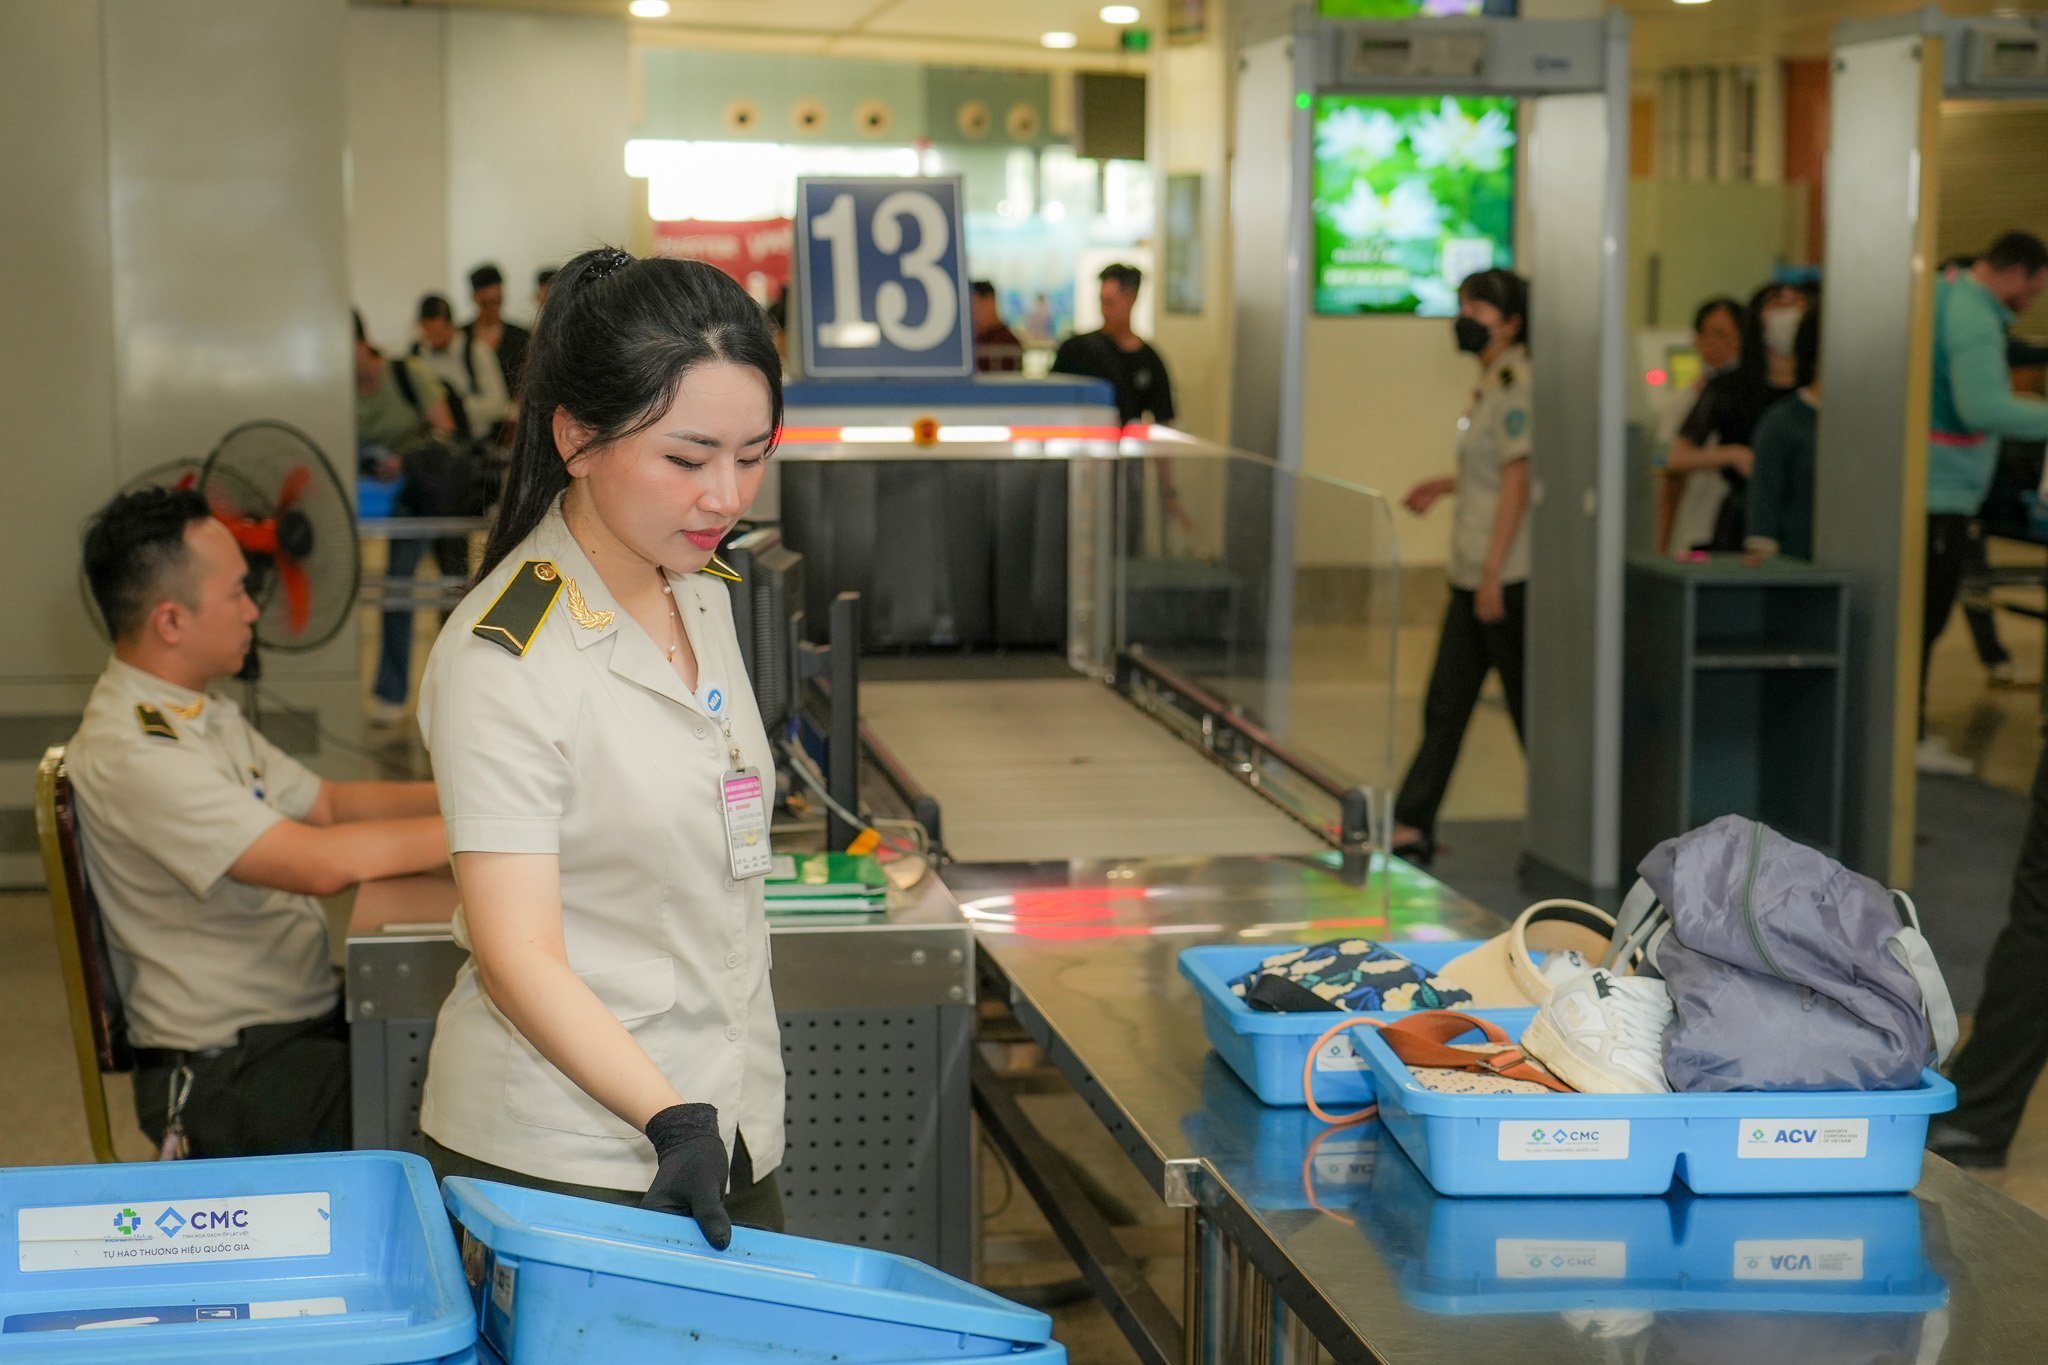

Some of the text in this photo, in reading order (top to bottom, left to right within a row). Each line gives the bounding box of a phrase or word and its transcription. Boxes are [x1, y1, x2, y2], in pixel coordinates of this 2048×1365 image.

[811, 190, 957, 352] 13
[1570, 1131, 1600, 1141] CMC
[1774, 1129, 1817, 1143] ACV
[190, 1209, 248, 1230] CMC
[103, 1242, 250, 1260] TỰ HÀO THƯƠNG HIỆU QUỐC GIA
